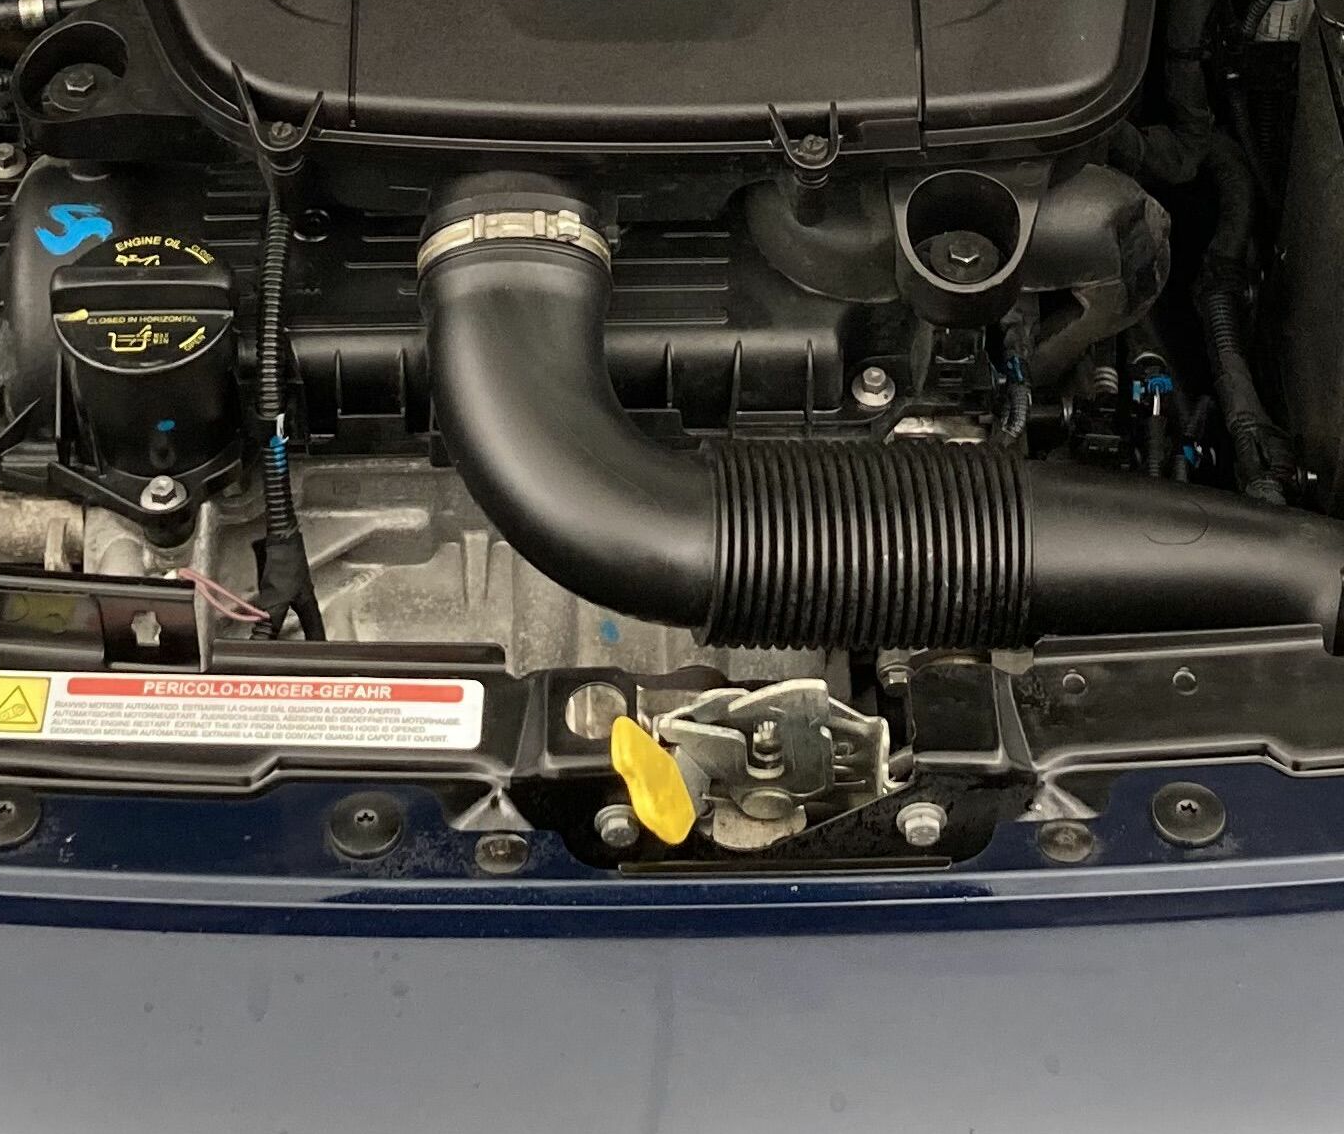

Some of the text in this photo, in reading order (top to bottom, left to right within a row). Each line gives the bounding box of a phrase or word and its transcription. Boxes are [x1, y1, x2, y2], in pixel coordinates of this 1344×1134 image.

[115, 235, 182, 251] ENGINE OIL
[86, 316, 126, 324] CLOSED
[139, 315, 197, 323] HORIZONTAL
[143, 681, 392, 699] PERICOLO-DANGER-GEFAHR
[284, 732, 324, 740] CONTACT
